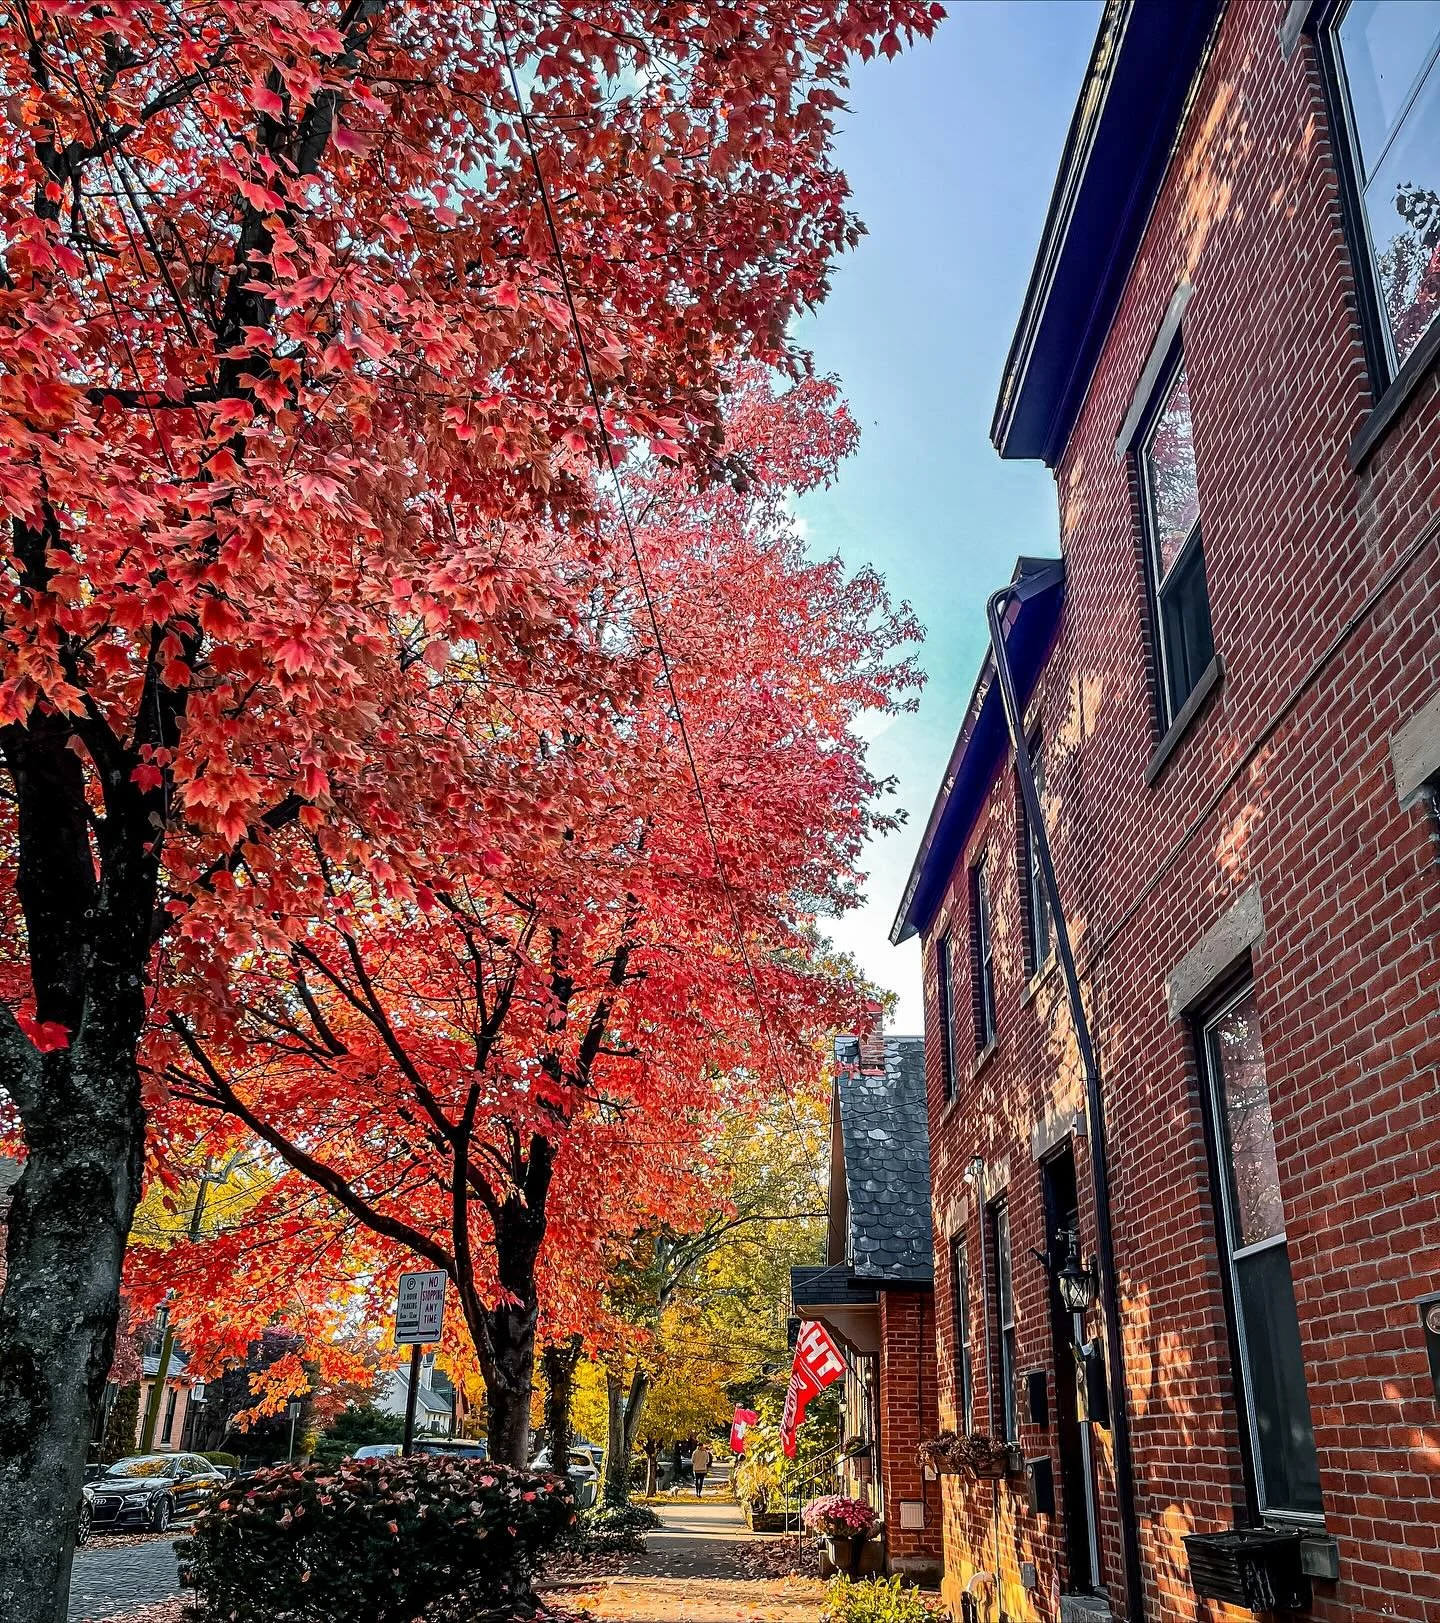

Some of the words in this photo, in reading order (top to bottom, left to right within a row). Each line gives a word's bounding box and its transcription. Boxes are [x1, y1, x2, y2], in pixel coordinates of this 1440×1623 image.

[428, 1276, 439, 1288] NO
[422, 1289, 443, 1301] STOPPING
[401, 1302, 418, 1310] PARKING
[425, 1303, 438, 1312] ANY
[424, 1314, 437, 1324] TIME
